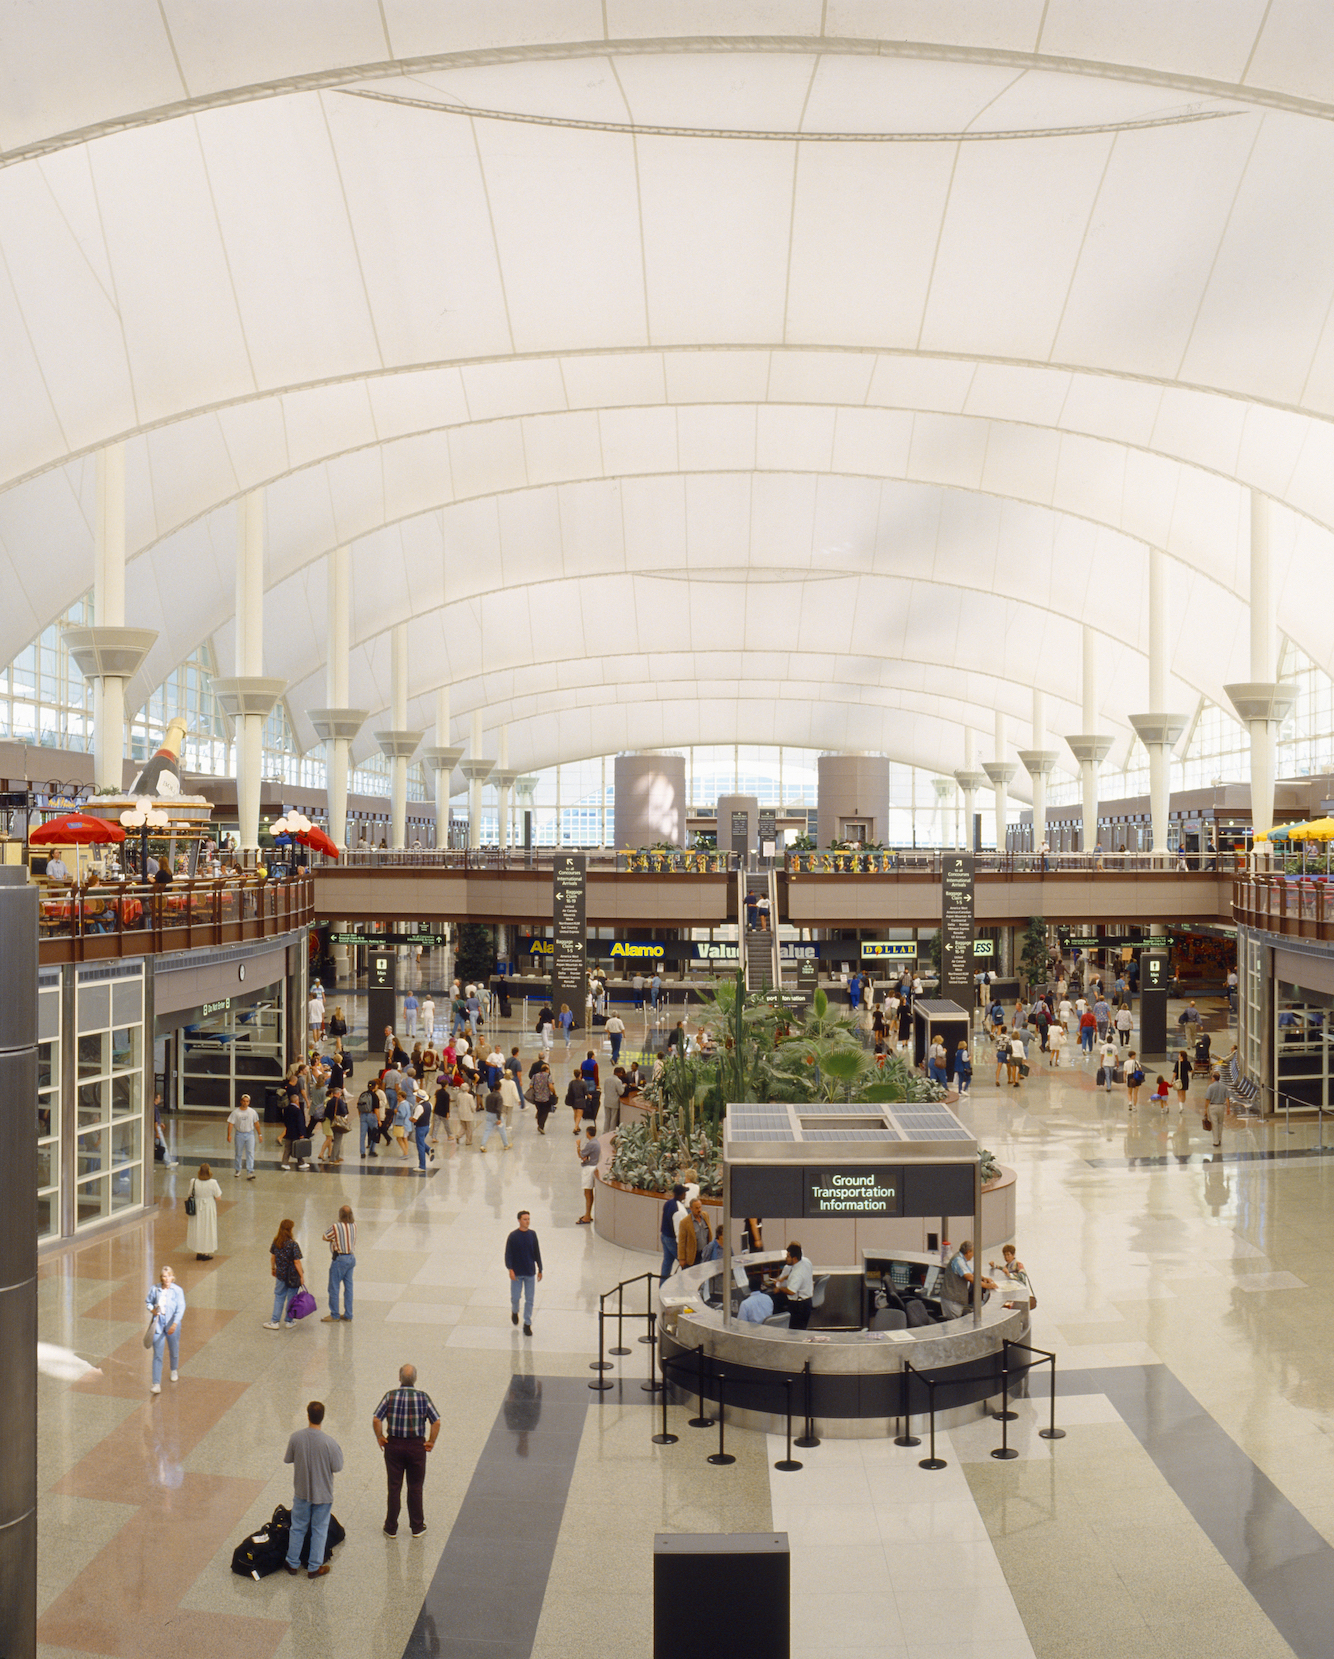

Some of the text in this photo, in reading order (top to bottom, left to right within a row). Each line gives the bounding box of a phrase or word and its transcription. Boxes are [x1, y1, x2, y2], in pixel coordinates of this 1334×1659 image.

[530, 940, 554, 953] Ala
[610, 942, 664, 957] Alamo
[866, 946, 914, 954] DOLLAR
[974, 942, 992, 952] ESS
[208, 1004, 212, 1013] Do
[832, 1174, 874, 1186] Ground
[812, 1186, 895, 1200] Transportation
[820, 1199, 886, 1210] Information
